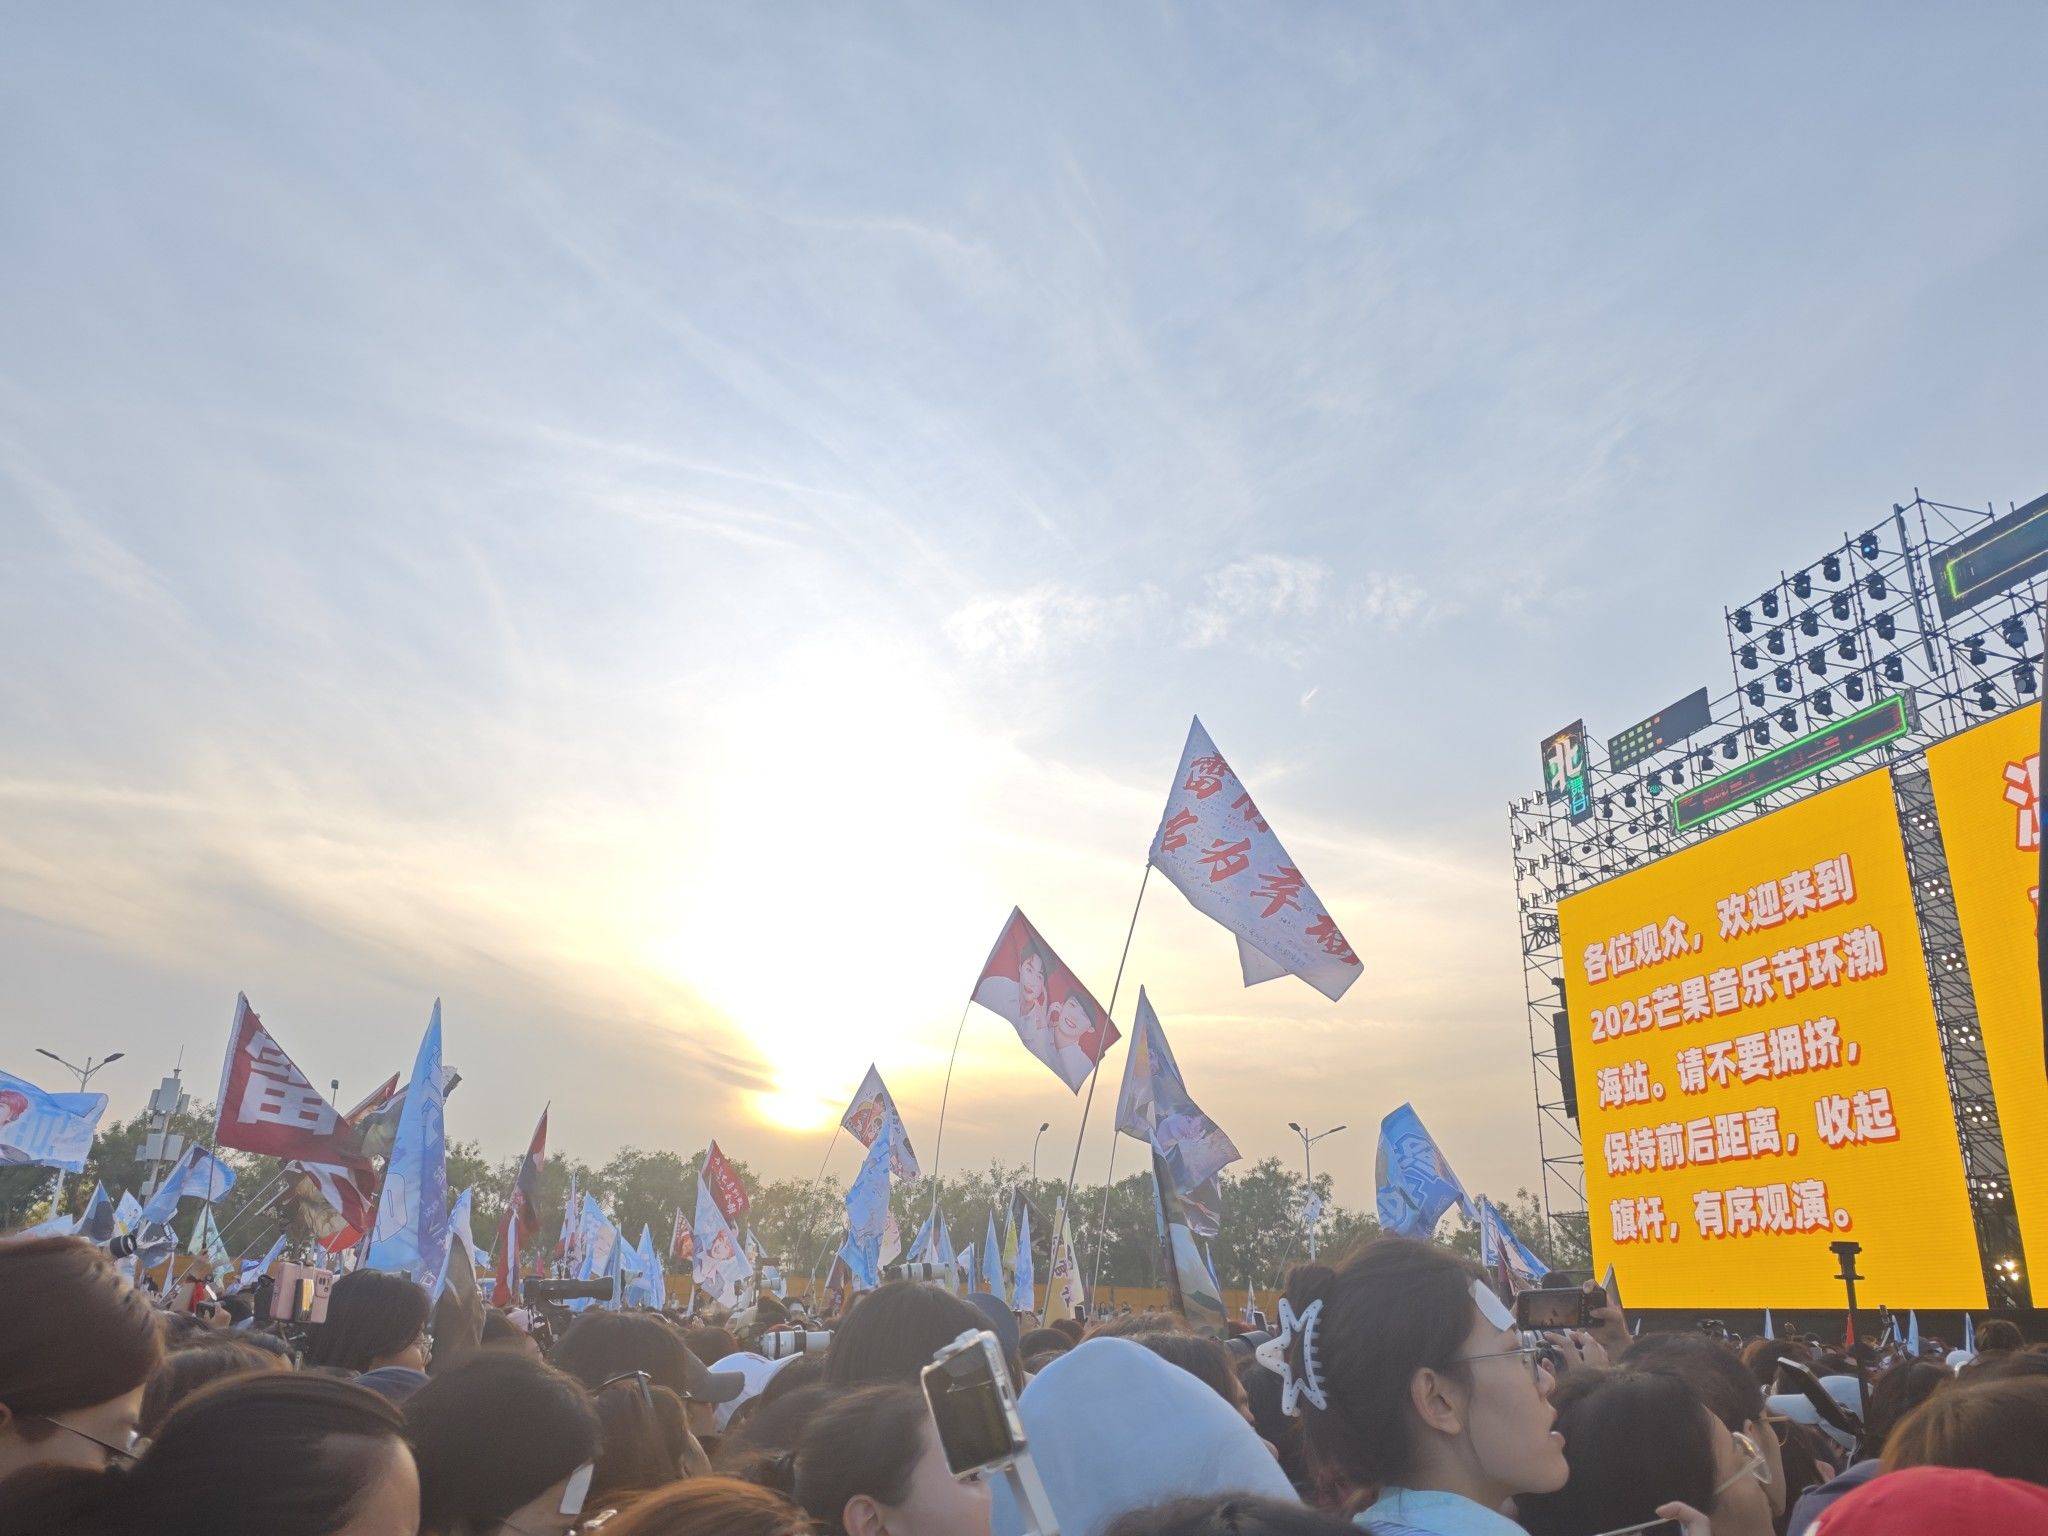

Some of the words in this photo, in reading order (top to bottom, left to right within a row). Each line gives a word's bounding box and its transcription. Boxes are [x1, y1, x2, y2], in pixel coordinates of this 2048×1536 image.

[1583, 855, 1855, 984] 各位观众，欢迎来到
[1590, 926, 1885, 1041] 2025芒果音乐节环渤
[1596, 1017, 1859, 1108] 海站。请不要拥挤，
[1603, 1088, 1897, 1174] 保持前后距离，收起
[1609, 1179, 1850, 1242] 旗杆，有序观演。
